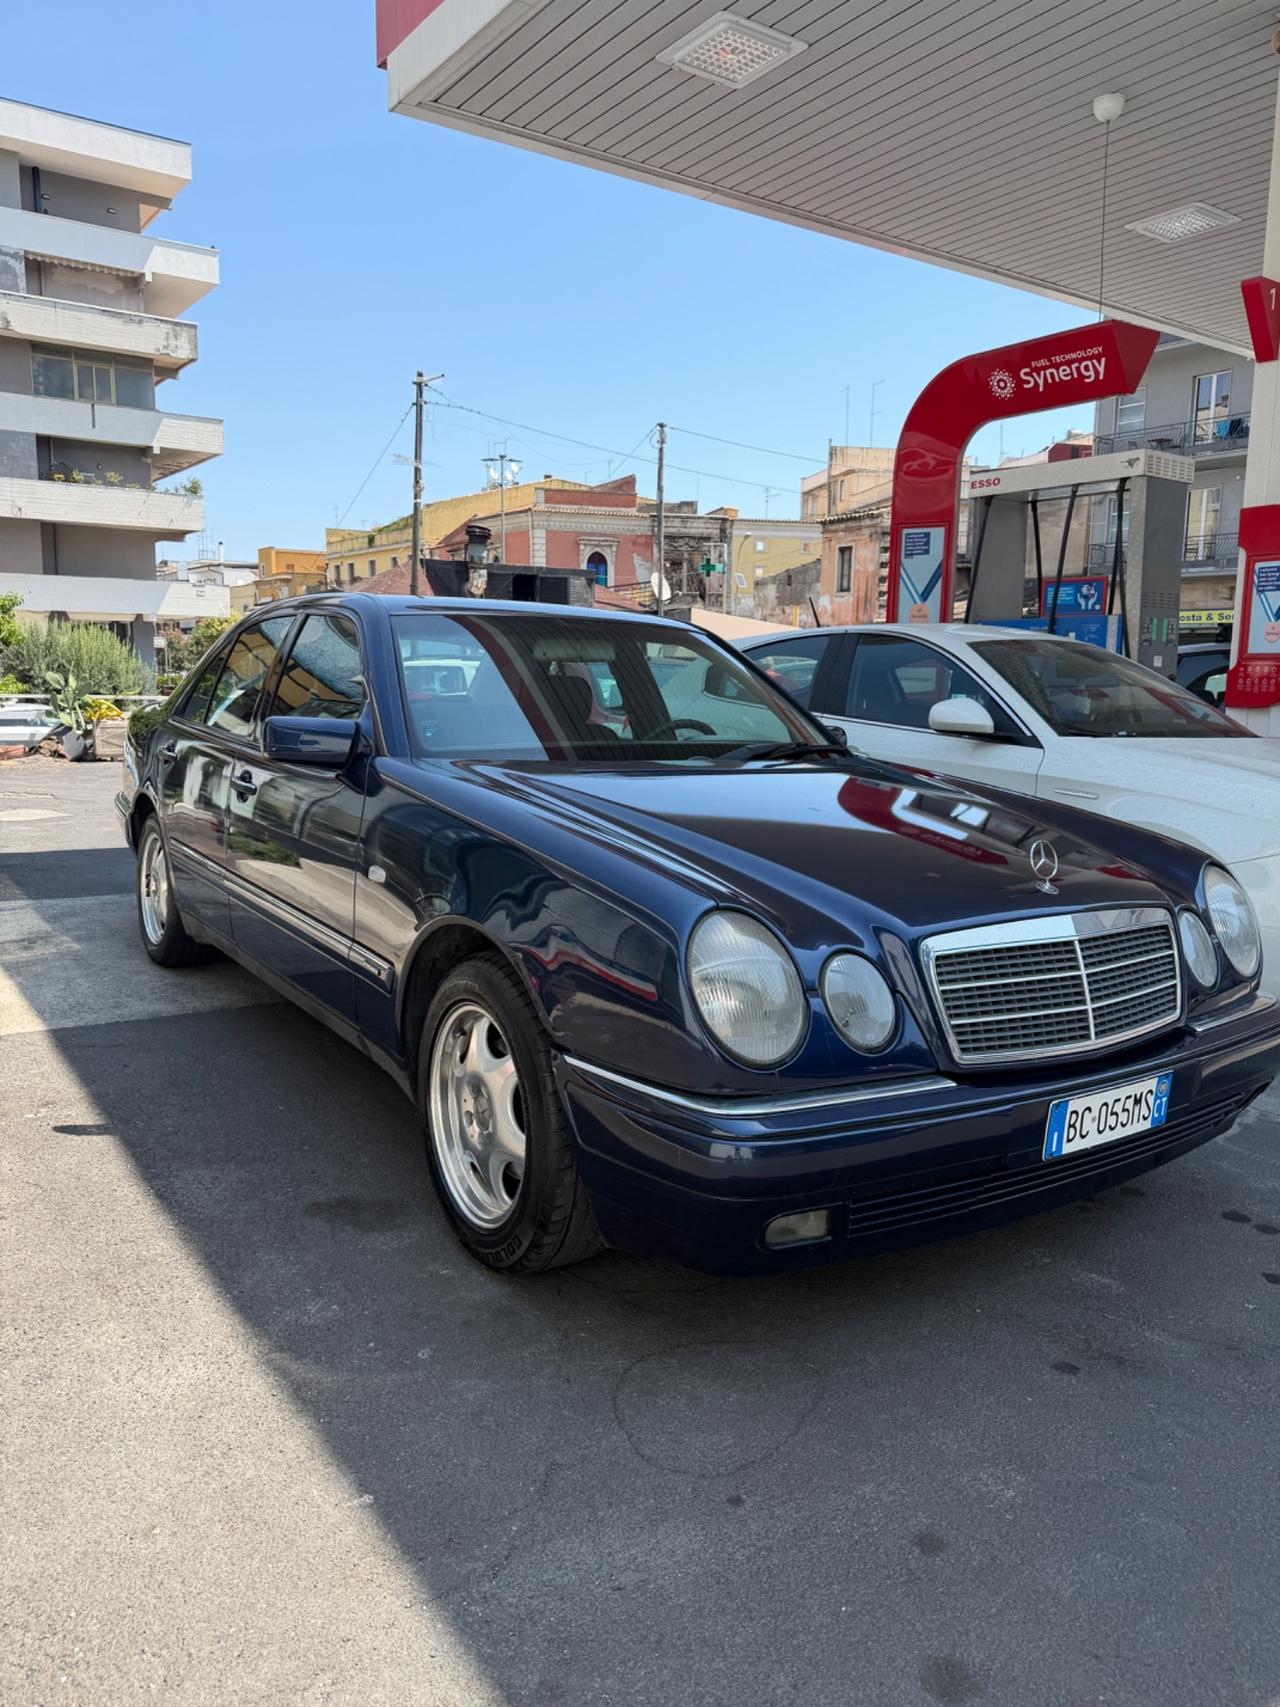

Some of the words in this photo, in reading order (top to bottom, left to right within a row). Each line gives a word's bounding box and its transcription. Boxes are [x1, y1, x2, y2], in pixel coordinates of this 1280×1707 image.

[1031, 358, 1051, 368] FUEL
[1050, 345, 1104, 363] TECHNOLOGY
[1019, 356, 1106, 392] Synergy
[970, 477, 1001, 489] ESSO
[1206, 612, 1214, 621] &
[1153, 1098, 1167, 1118] CT
